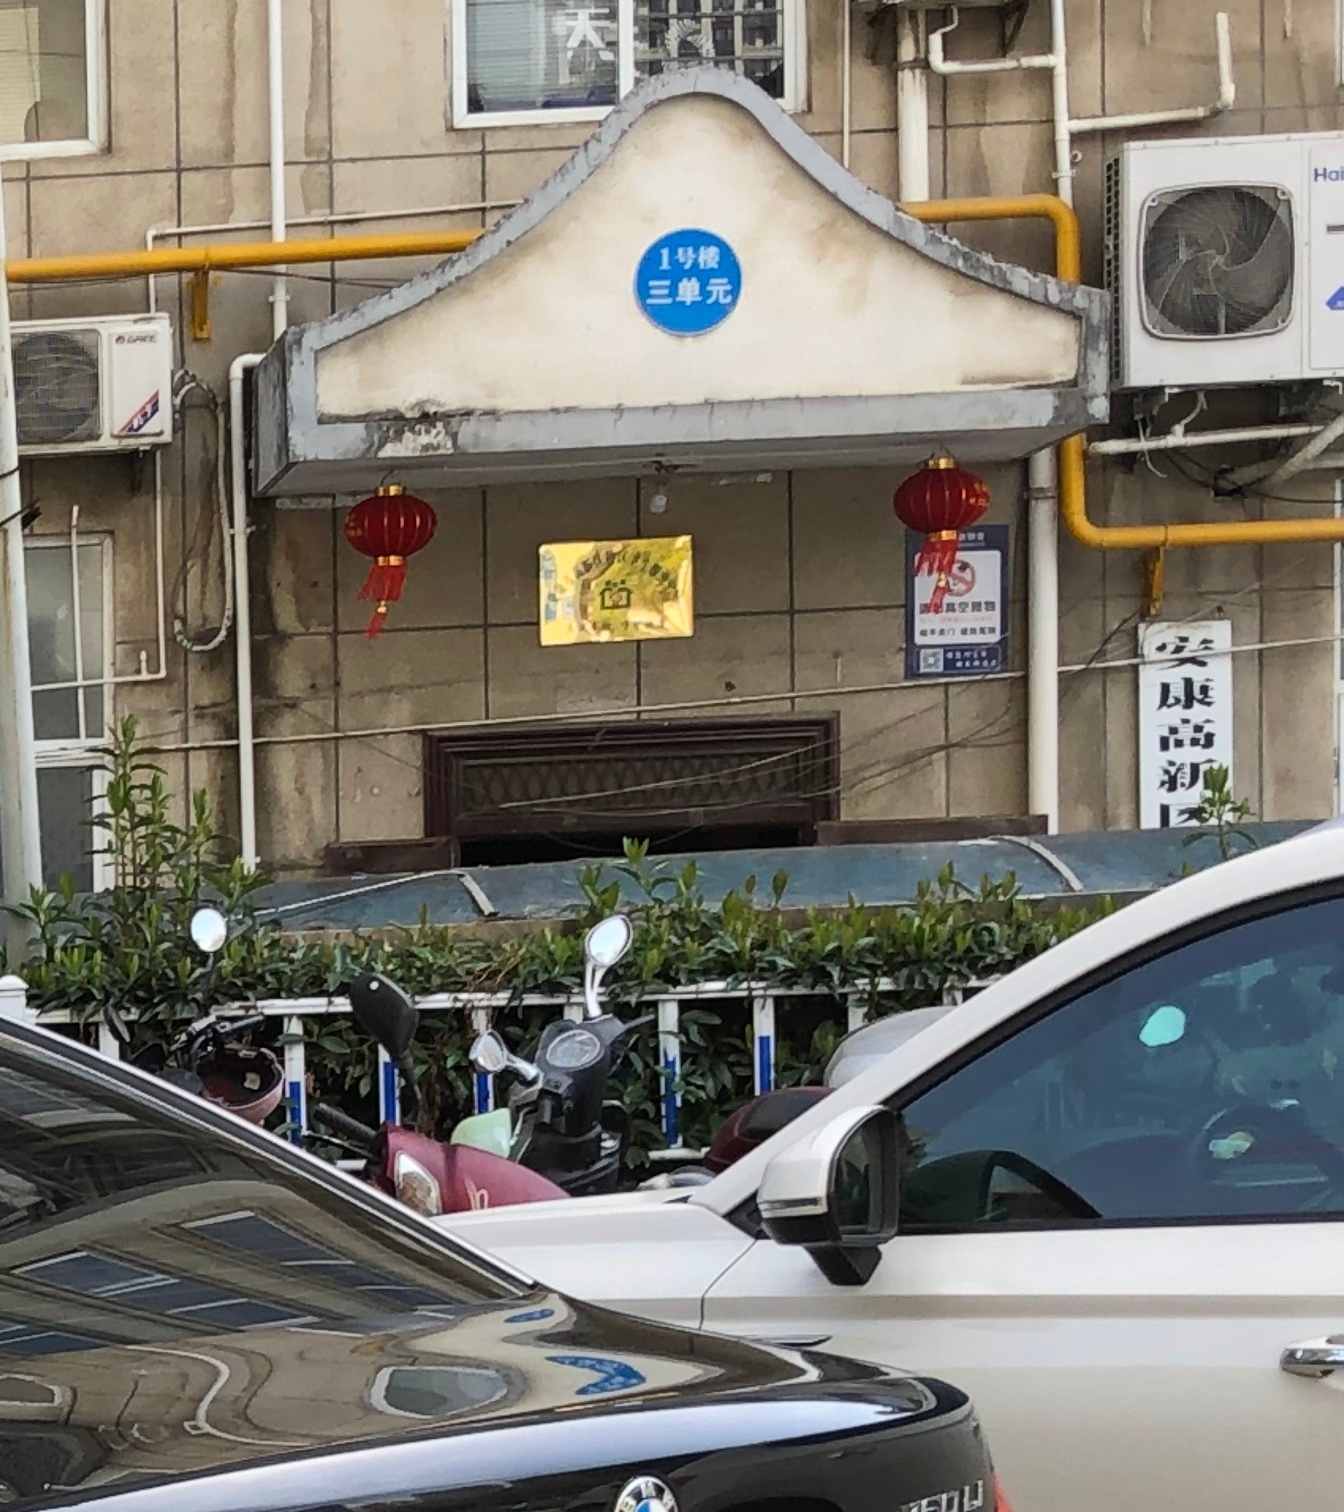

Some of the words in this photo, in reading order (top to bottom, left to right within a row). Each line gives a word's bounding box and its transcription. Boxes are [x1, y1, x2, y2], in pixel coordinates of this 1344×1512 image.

[658, 244, 720, 270] 1号楼
[645, 276, 733, 306] 三单元
